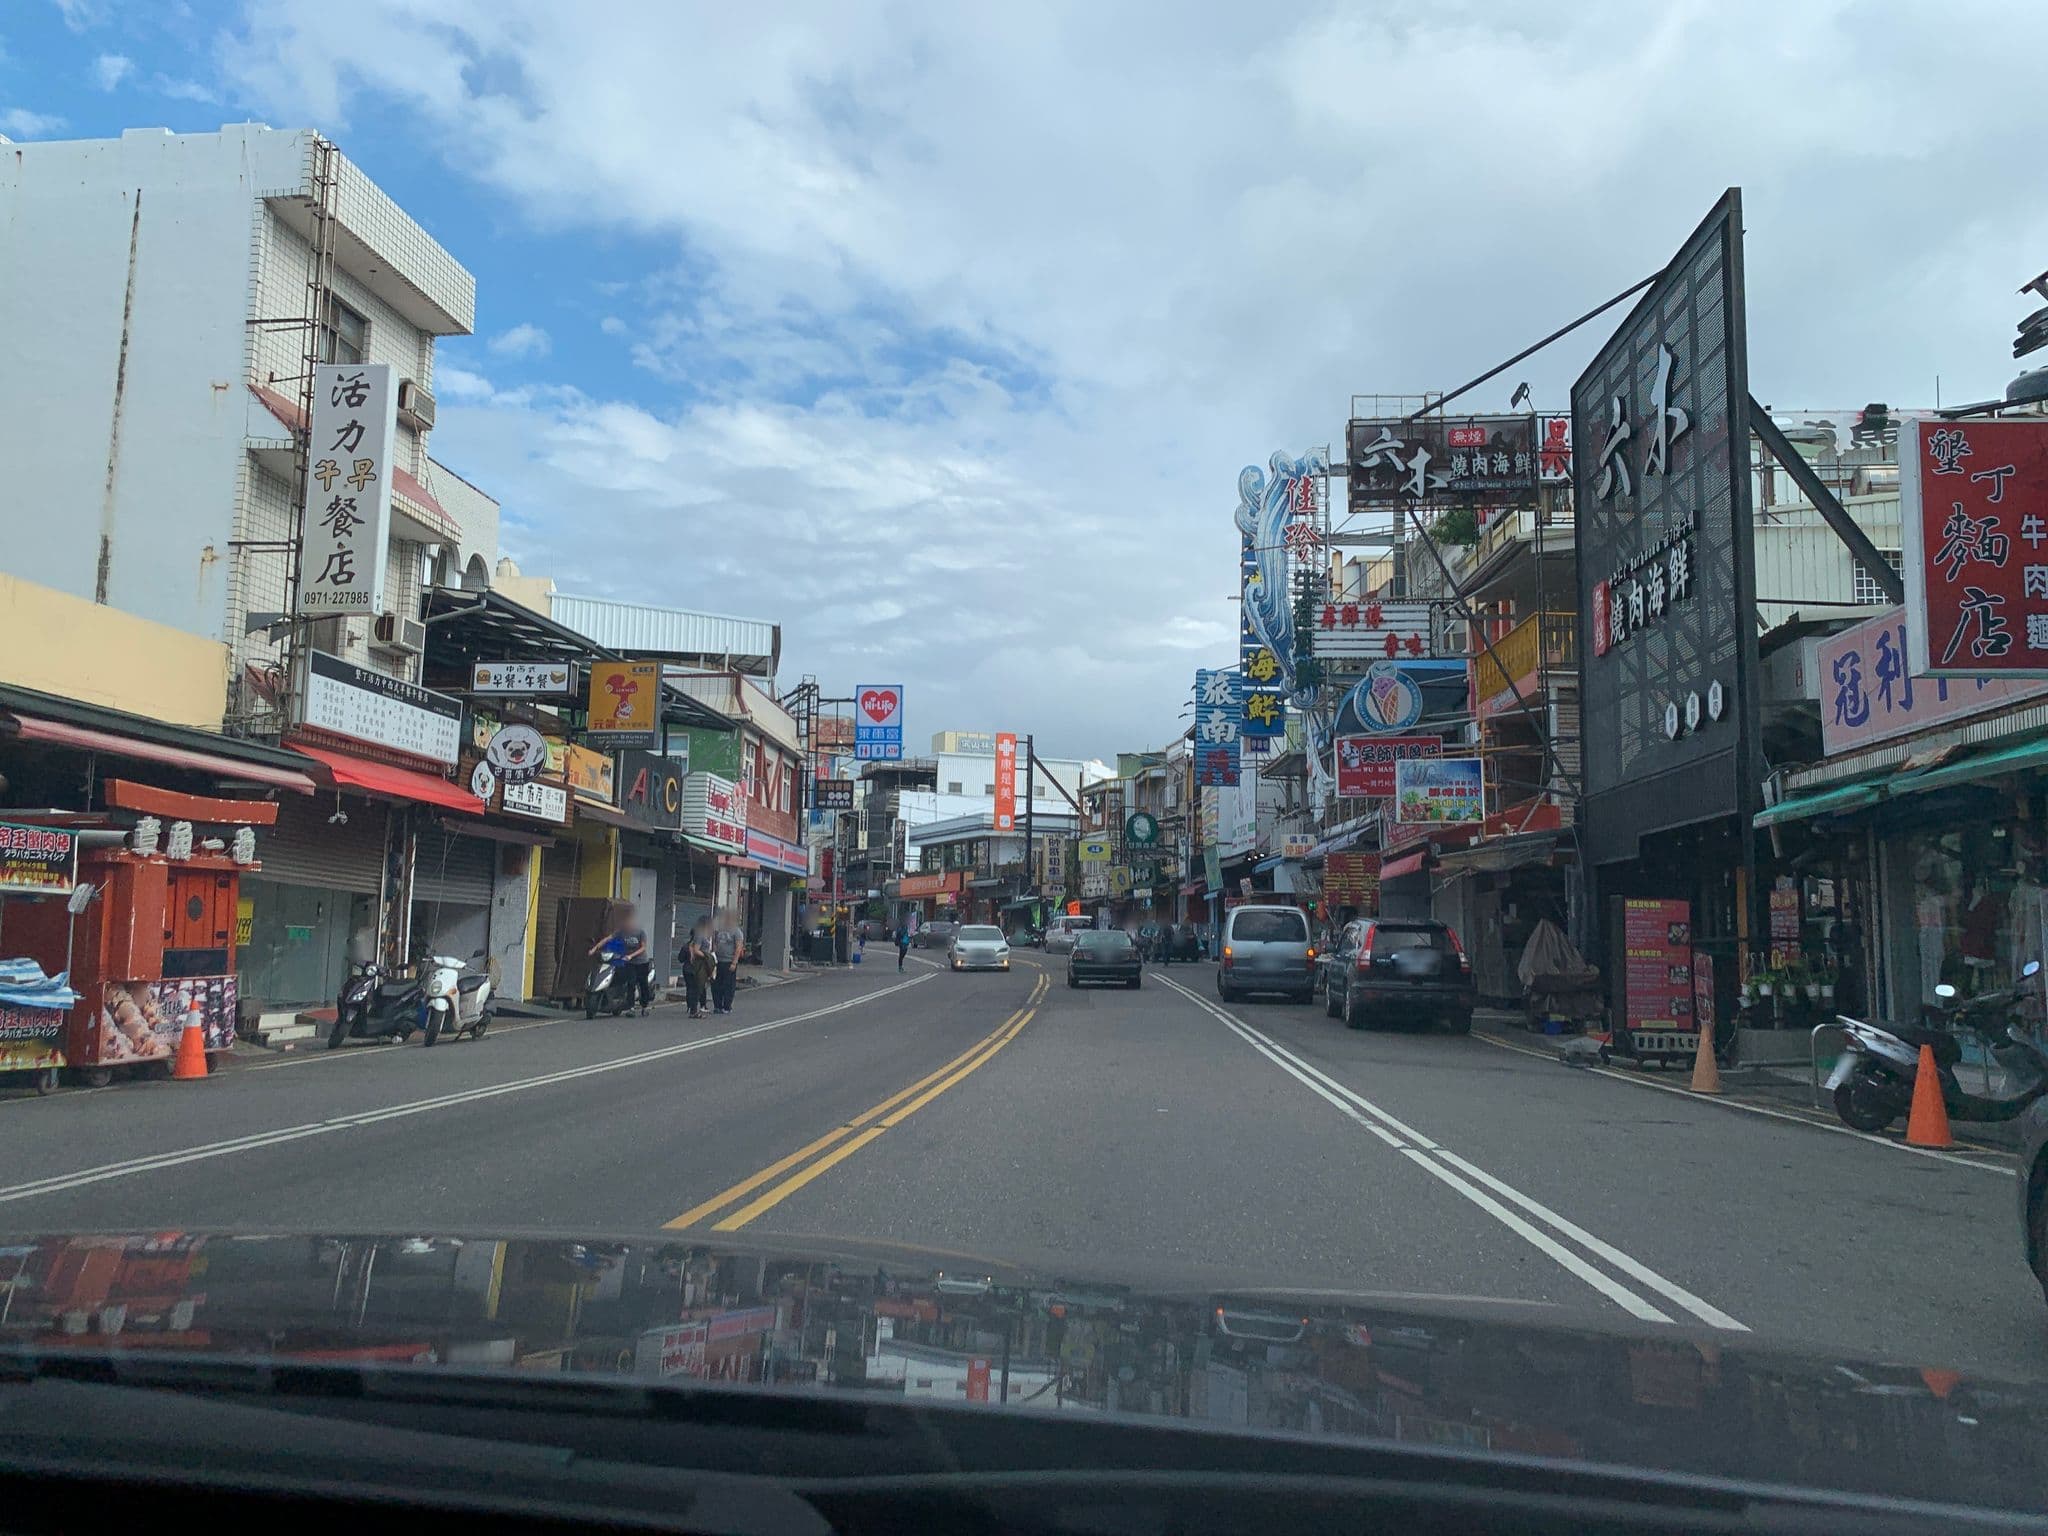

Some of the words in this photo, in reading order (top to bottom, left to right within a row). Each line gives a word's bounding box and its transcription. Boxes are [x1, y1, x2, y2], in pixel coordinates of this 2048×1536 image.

[1451, 451, 1532, 477] 燒肉海鮮
[304, 591, 369, 605] 0971-227985
[1609, 540, 1689, 647] 燒肉海鮮
[1247, 649, 1279, 726] 海鮮
[627, 767, 678, 813] ARC
